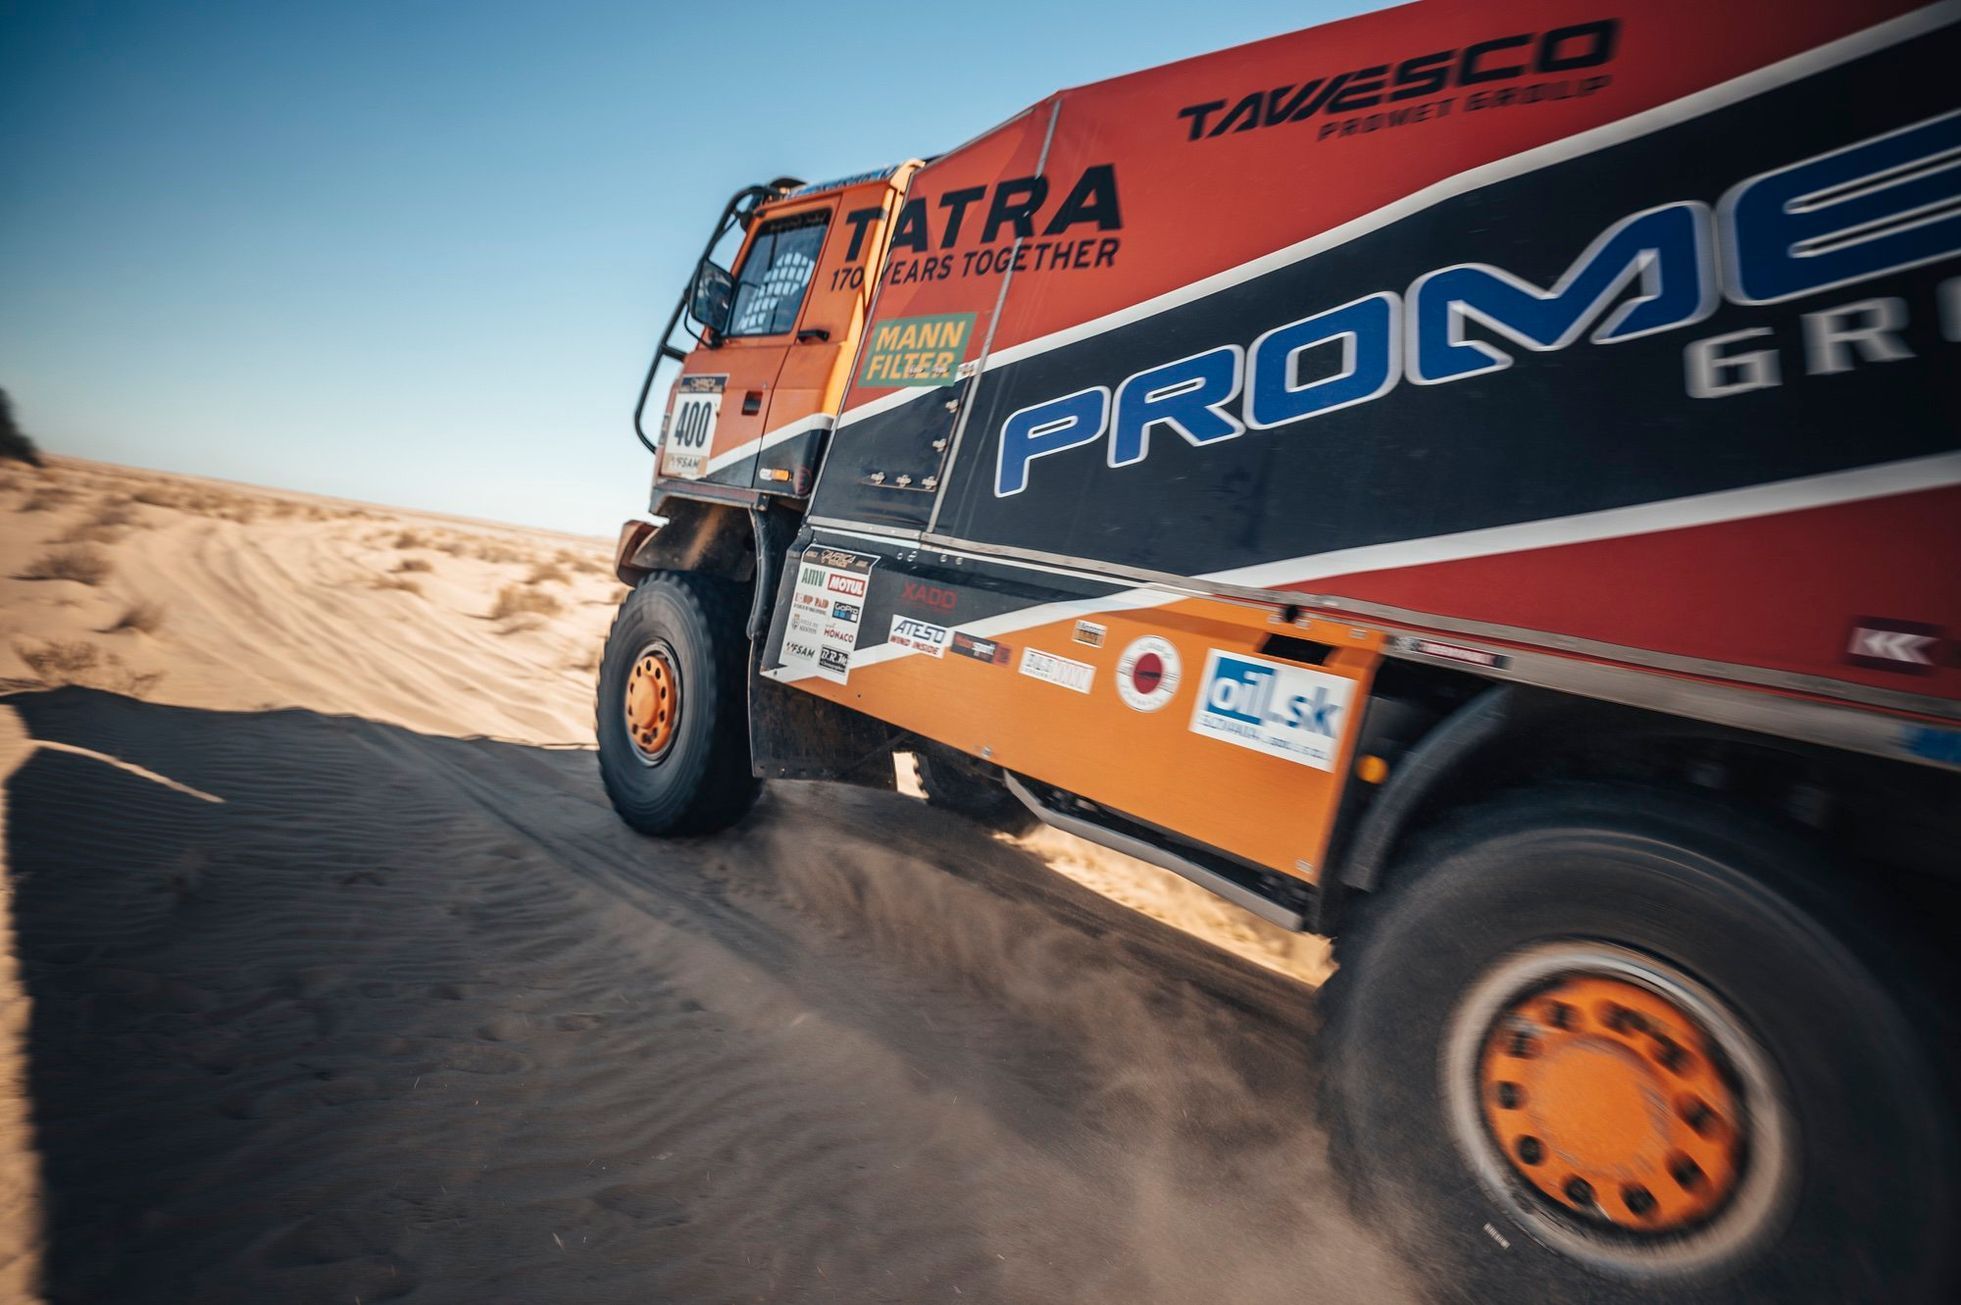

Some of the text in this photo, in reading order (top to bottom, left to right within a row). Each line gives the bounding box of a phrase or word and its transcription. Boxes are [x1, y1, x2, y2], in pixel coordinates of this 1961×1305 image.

[1178, 18, 1621, 141] TAWESCO
[1317, 75, 1611, 141] PROMET GROUP
[845, 163, 1123, 263] TATRA
[830, 238, 1120, 291] 170 YEARS TOGETHER
[875, 321, 966, 352] MANN
[866, 351, 955, 380] FILTER
[674, 401, 711, 448] 400
[829, 575, 863, 595] MOTUL
[903, 581, 957, 609] XADO
[824, 627, 854, 643] MONACO
[894, 620, 946, 644] ATESO
